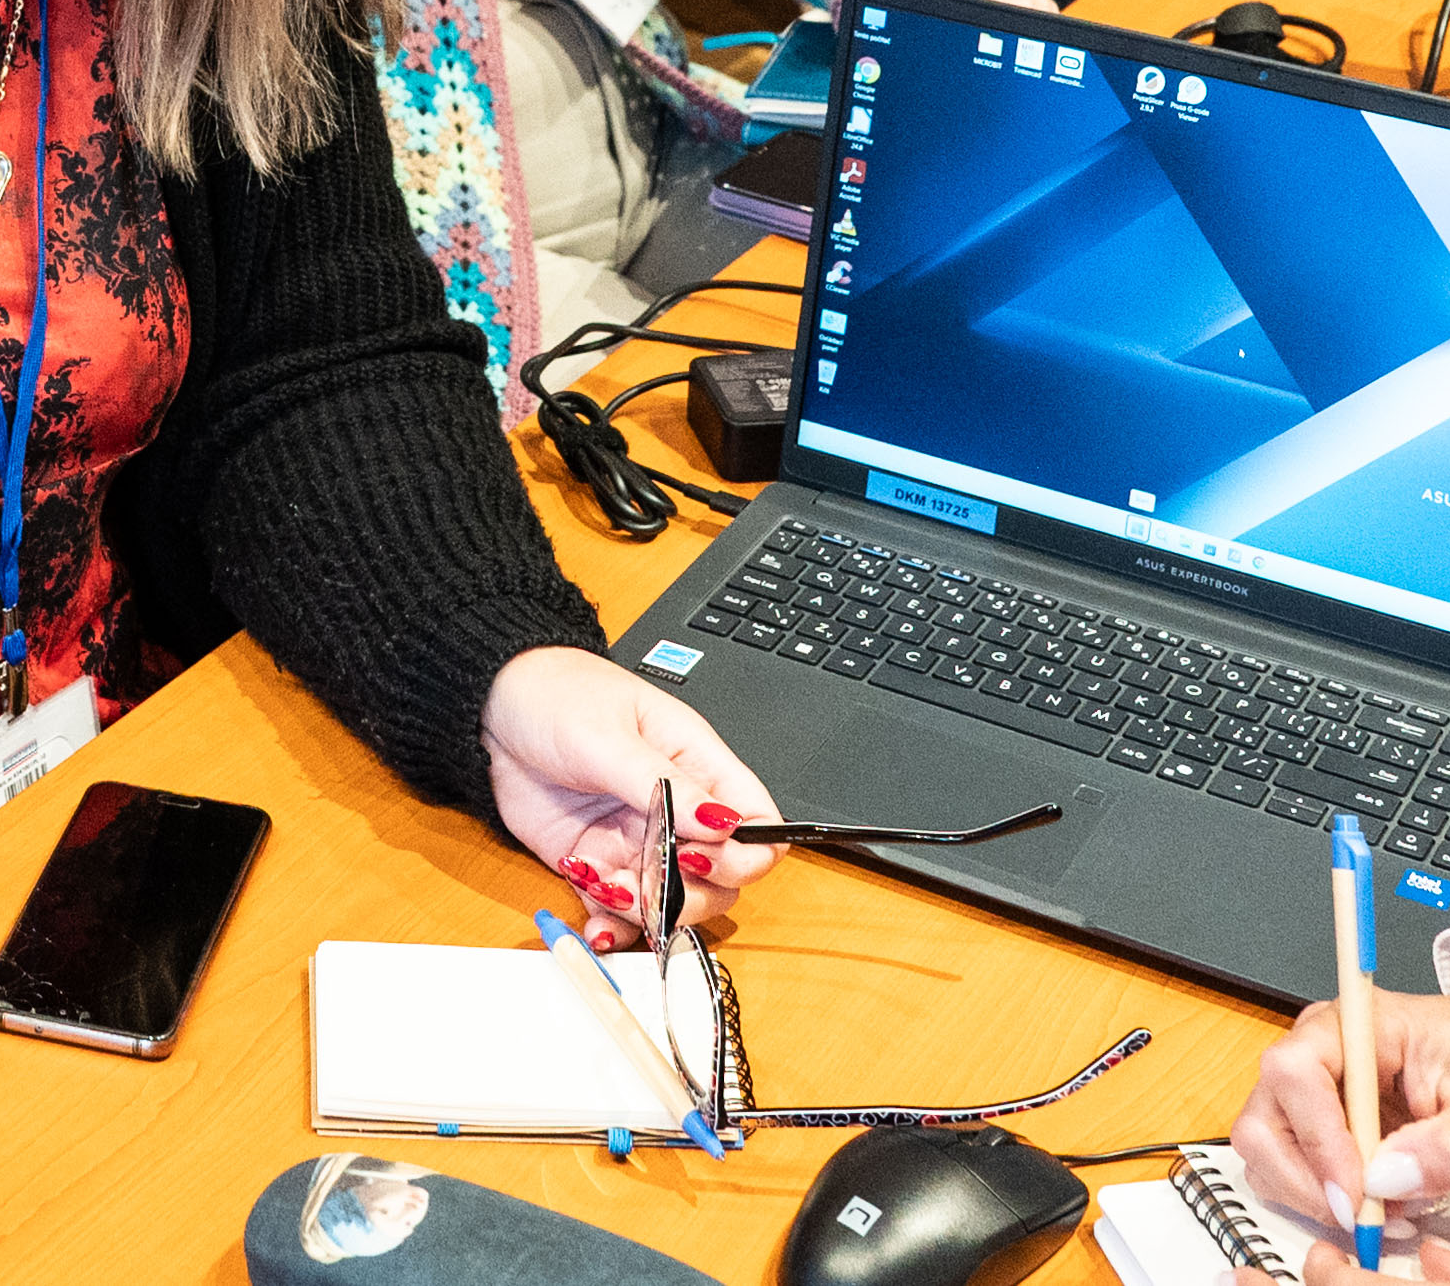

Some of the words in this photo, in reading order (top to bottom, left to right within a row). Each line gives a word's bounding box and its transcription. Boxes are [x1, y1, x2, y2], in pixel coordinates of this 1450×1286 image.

[854, 83, 876, 94] Google
[853, 91, 875, 102] Chrome
[843, 132, 874, 144] LibreOffice
[841, 184, 861, 195] Adobe
[839, 192, 862, 203] Acrobat
[825, 283, 850, 295] CCleaner
[894, 486, 928, 508] DKM
[930, 496, 970, 521] 13725
[1135, 556, 1167, 574] ASUS
[1170, 566, 1250, 597] EXPERTBOOK
[861, 585, 879, 596] W
[900, 623, 913, 632] D
[860, 637, 873, 647] X
[906, 652, 920, 661] C
[1091, 656, 1105, 666] U
[1039, 666, 1054, 676] H
[1046, 695, 1061, 705] N
[1135, 696, 1148, 706] K
[1092, 710, 1110, 721] M
